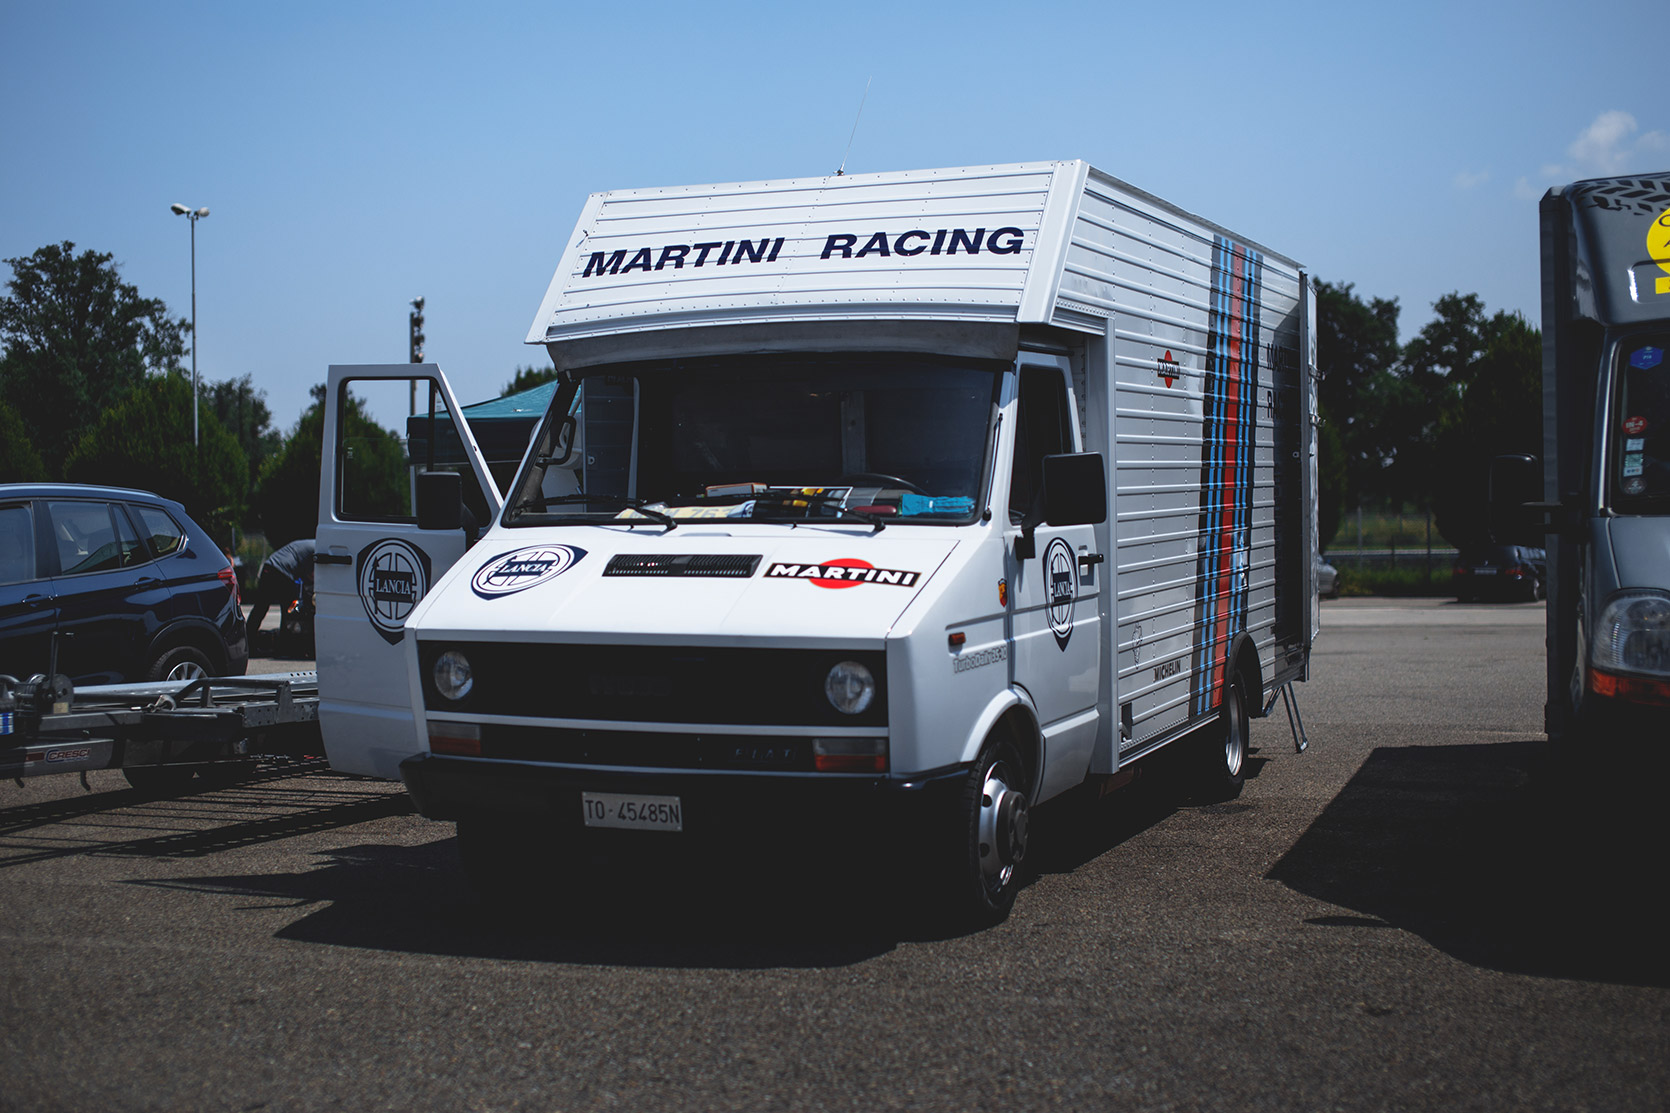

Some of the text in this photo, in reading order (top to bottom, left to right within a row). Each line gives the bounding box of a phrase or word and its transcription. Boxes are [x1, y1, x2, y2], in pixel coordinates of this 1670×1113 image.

[582, 227, 1025, 278] MARTINI RACING
[499, 563, 547, 574] LANCIA
[770, 564, 915, 585] MARTINI
[376, 578, 411, 594] LANCIA
[1053, 581, 1072, 598] LANCIA
[1153, 659, 1181, 683] MICHELIN
[46, 749, 91, 763] CRESCI
